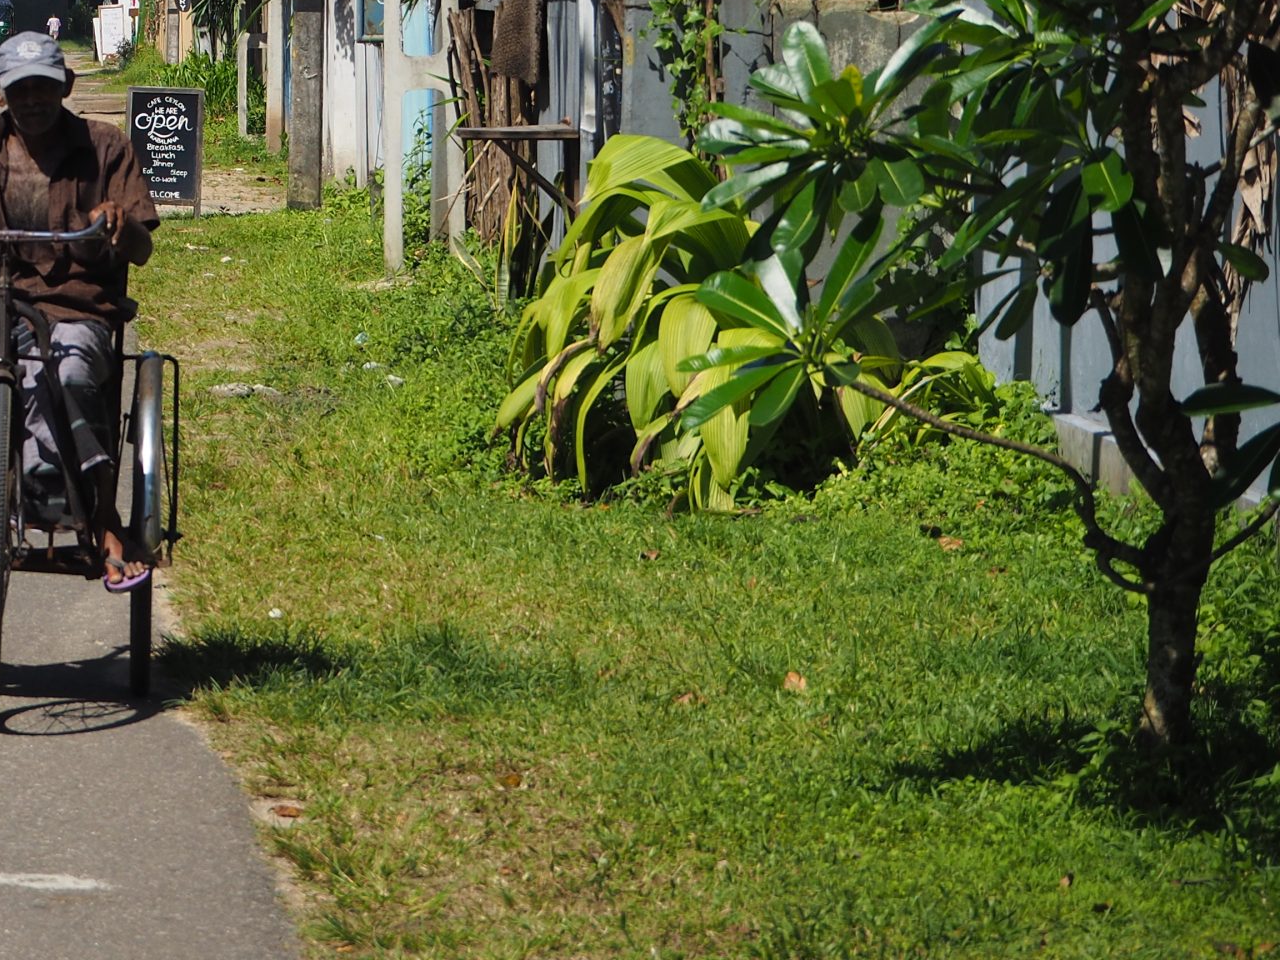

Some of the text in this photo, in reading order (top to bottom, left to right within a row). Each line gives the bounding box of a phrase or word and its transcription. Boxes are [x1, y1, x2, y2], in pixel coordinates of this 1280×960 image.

[147, 96, 186, 112] CAFE CEYLON
[165, 107, 179, 115] ARE
[149, 135, 180, 144] KABALANA
[151, 151, 176, 159] Lunch
[152, 159, 175, 167] Dinner
[170, 169, 188, 178] Sleep
